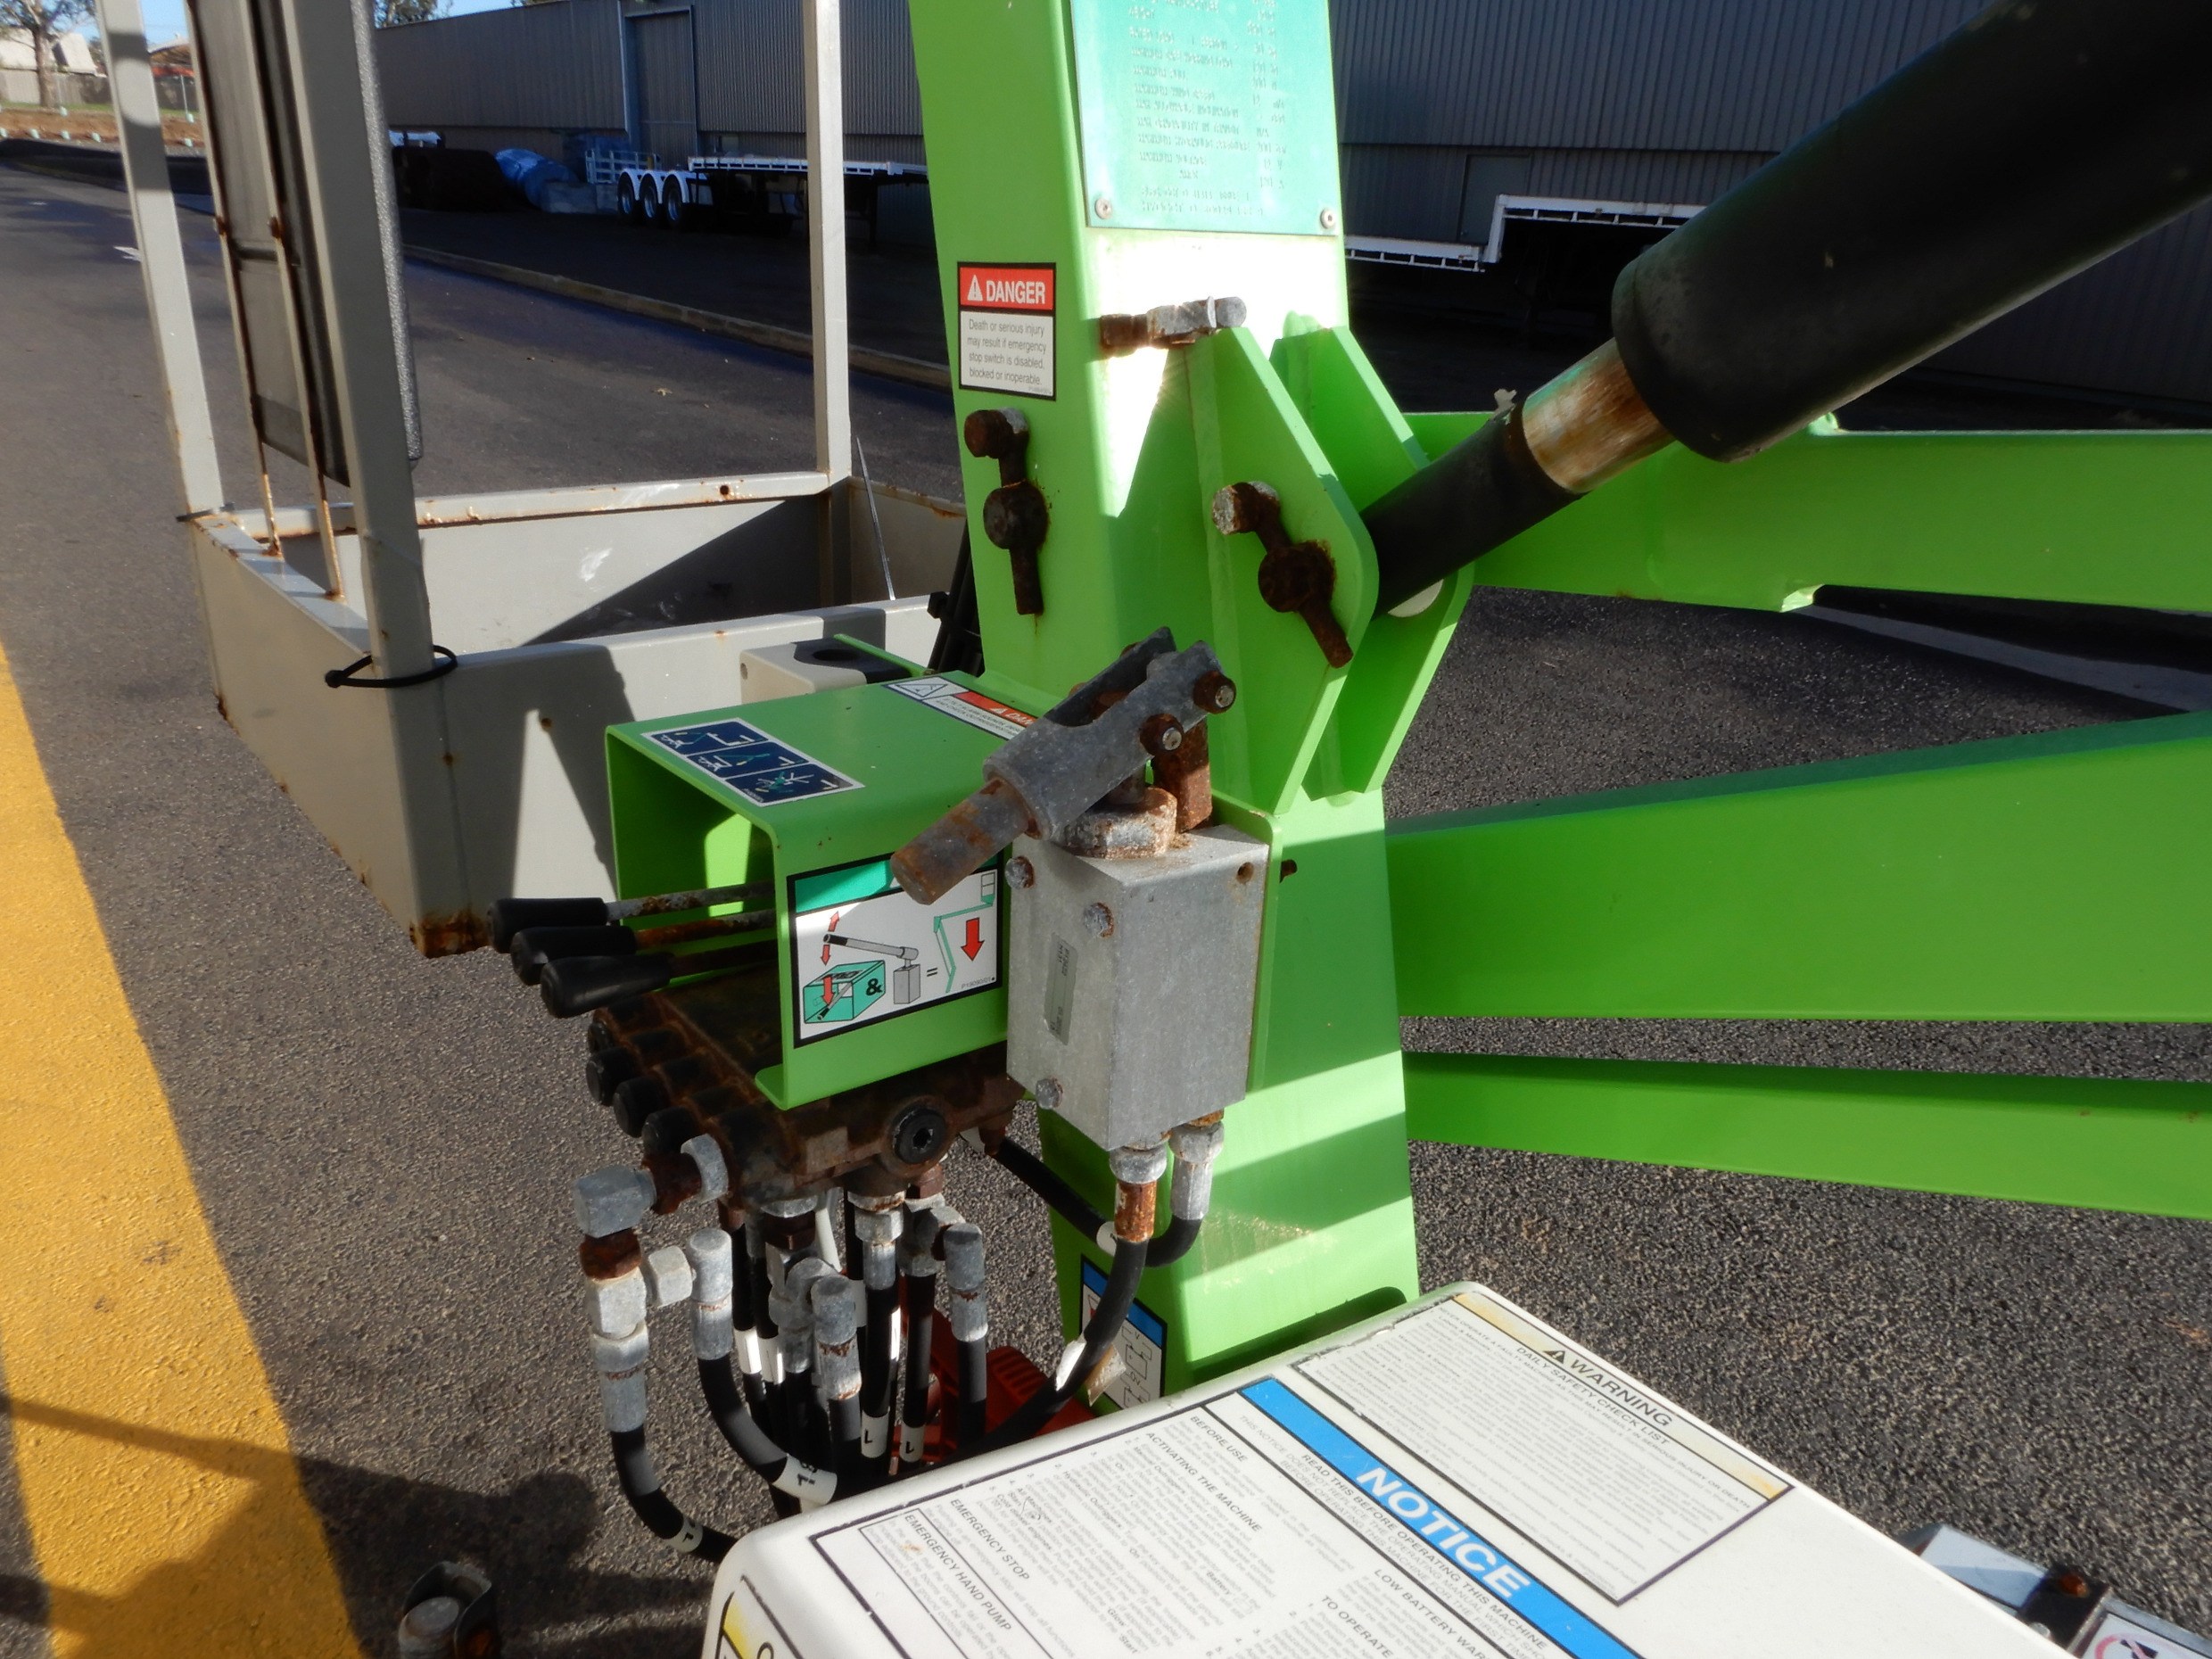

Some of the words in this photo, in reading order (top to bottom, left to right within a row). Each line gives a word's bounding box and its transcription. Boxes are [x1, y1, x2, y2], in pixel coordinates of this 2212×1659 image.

[986, 280, 1045, 304] DANGER
[967, 336, 980, 349] may
[982, 337, 1001, 349] result
[1002, 339, 1007, 348] if
[1008, 341, 1046, 355] emergency
[969, 352, 983, 363] stop
[985, 354, 1004, 365] switch
[1006, 356, 1011, 366] is
[970, 318, 988, 330] Death
[990, 322, 997, 331] or
[999, 320, 1024, 334] serious
[1026, 322, 1045, 337] injury
[970, 367, 995, 380] blocked
[995, 371, 1003, 381] or
[1004, 371, 1042, 385] inoperable.
[1515, 1347, 1551, 1369] DAILY
[1548, 1368, 1597, 1399] SAFETY
[1594, 1398, 1641, 1427] CHECK
[1638, 1425, 1670, 1446] LIST
[1564, 1359, 1676, 1426] WARNING
[1188, 1416, 1228, 1446] BEFORE
[1224, 1444, 1248, 1462] USE
[1143, 1431, 1199, 1476] ACTIVATING
[1194, 1475, 1218, 1493] THE
[1213, 1491, 1262, 1531] MACHINE
[949, 1498, 1006, 1554] EMERGENCY
[1000, 1553, 1031, 1581] STOP
[1299, 1454, 1332, 1478] READ
[1327, 1477, 1356, 1497] THIS
[1350, 1495, 1399, 1531] BEFORE
[1394, 1530, 1463, 1582] OPERATING
[1459, 1581, 1491, 1605] THIS
[1486, 1603, 1548, 1651] MACHINE
[1353, 1466, 1532, 1598] NOTICE
[904, 1514, 961, 1572] EMERGENCY
[953, 1570, 986, 1601] HAND
[978, 1599, 1013, 1632] PUMP
[1373, 1569, 1403, 1592] LOW
[1400, 1591, 1457, 1636] BATTERY
[1319, 1595, 1340, 1611] TO
[1335, 1610, 1393, 1658] OPERATE
